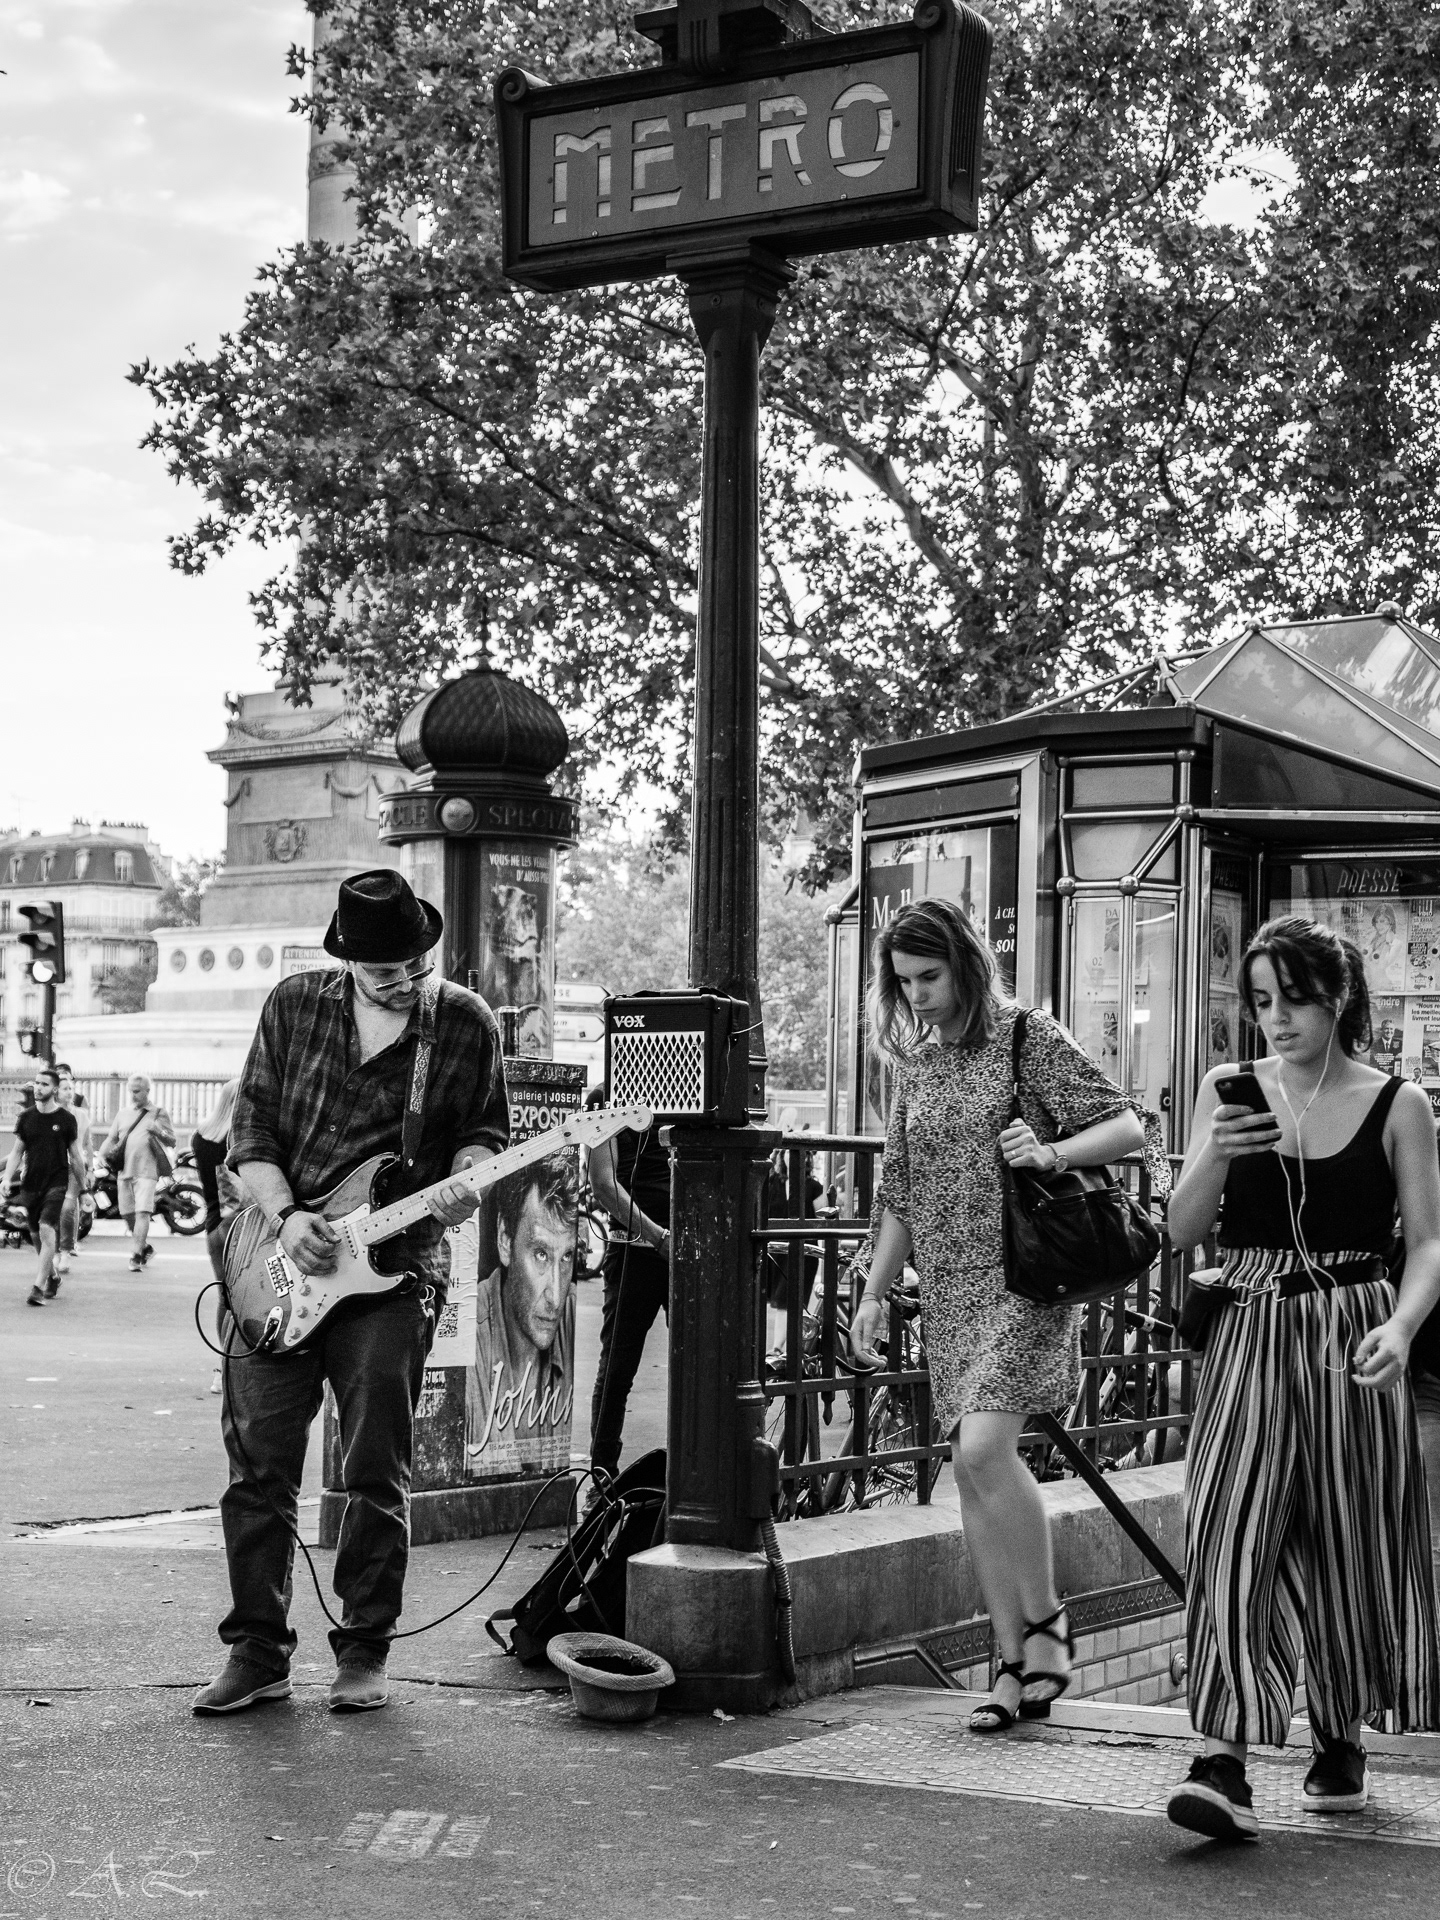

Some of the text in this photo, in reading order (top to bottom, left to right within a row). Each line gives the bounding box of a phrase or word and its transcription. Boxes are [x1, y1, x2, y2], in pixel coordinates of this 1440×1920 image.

[552, 81, 894, 225] METRO
[489, 854, 509, 866] VOUS
[511, 854, 520, 867] NE
[521, 855, 532, 867] LES
[1336, 867, 1403, 893] PRESSE
[613, 1015, 646, 1028] VOX
[512, 1090, 581, 1103] galerie JOSEPH
[527, 1131, 536, 1139] 23
